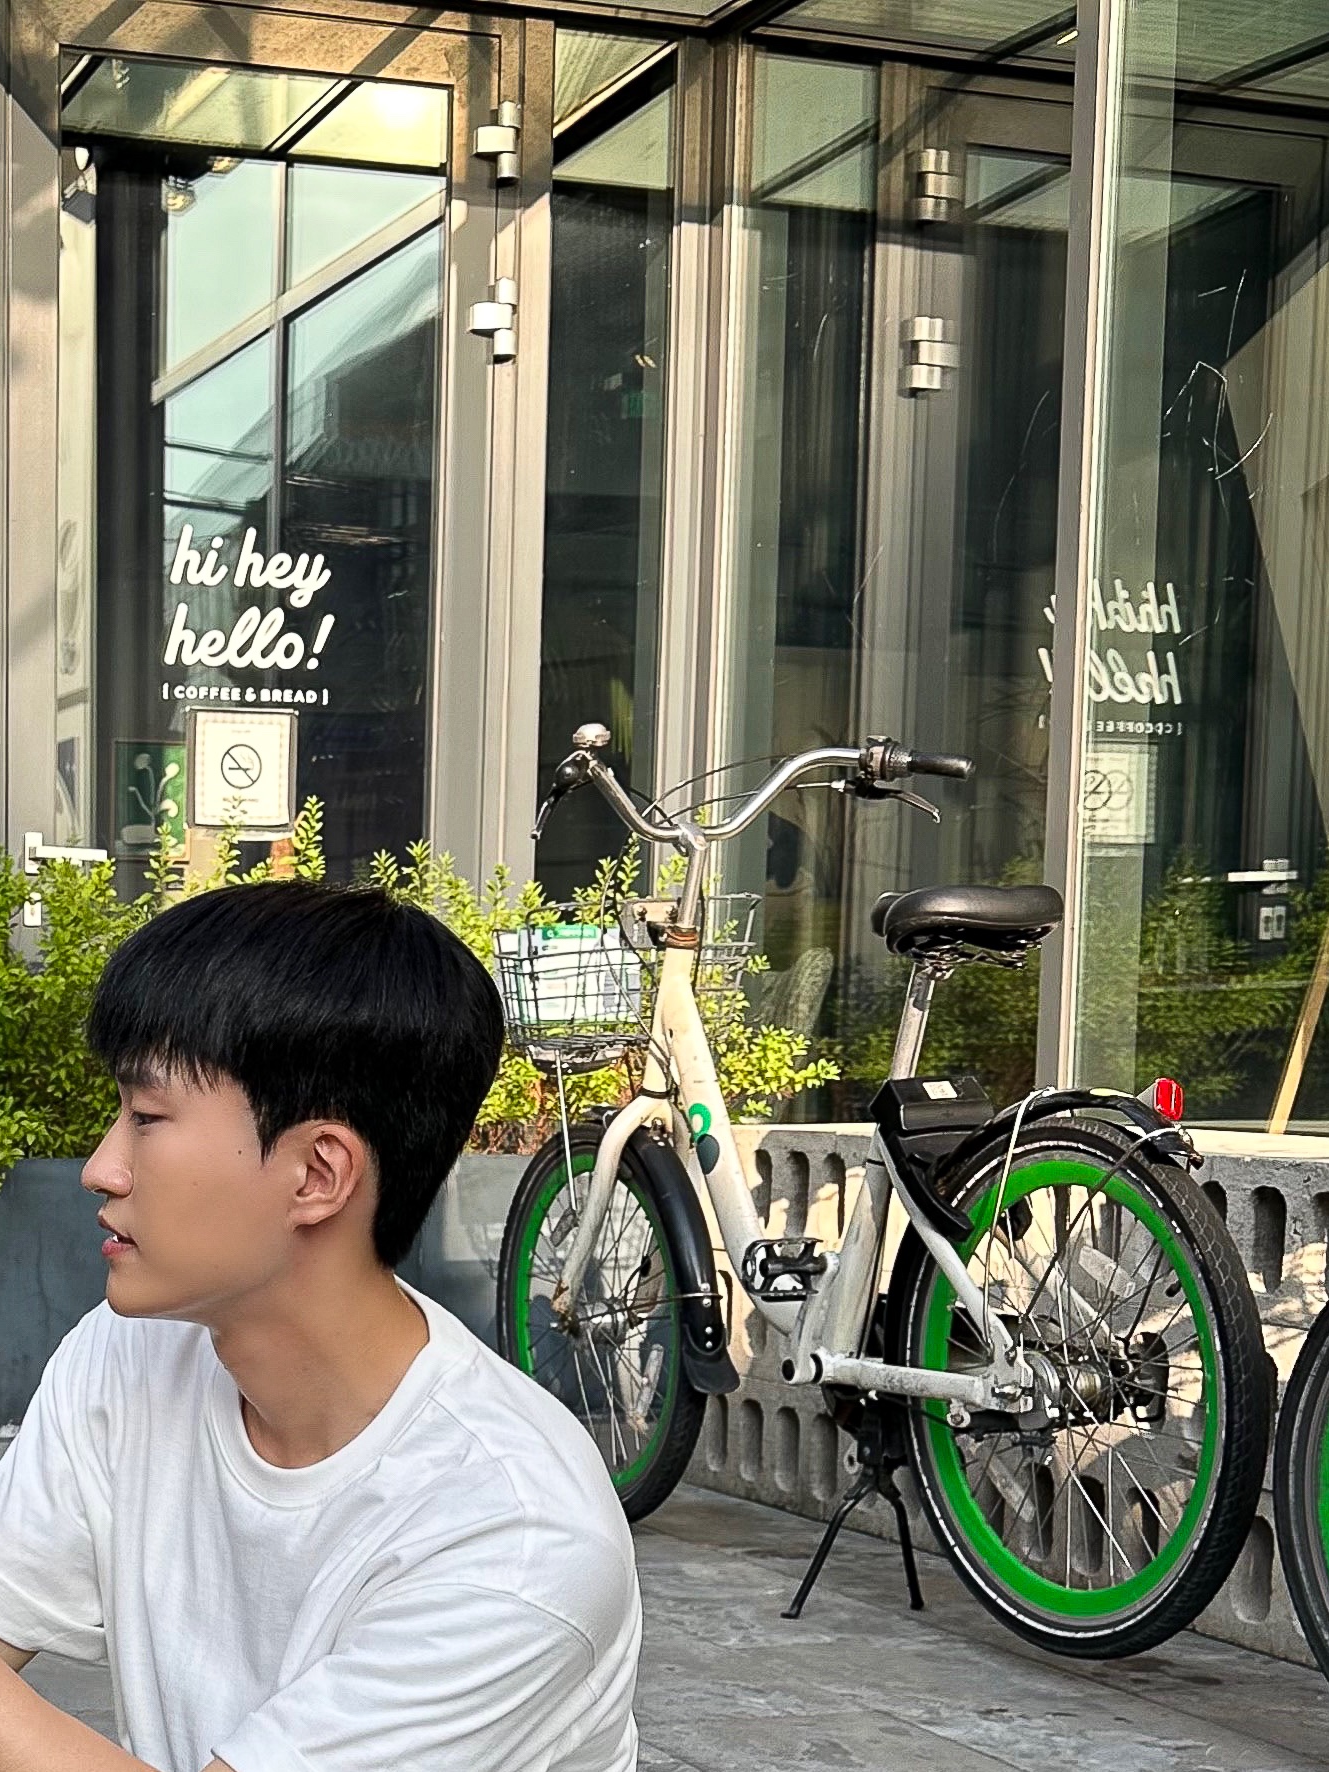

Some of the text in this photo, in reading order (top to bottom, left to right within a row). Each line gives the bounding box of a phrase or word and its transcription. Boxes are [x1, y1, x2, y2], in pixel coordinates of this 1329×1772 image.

[169, 523, 332, 608] hi hey
[163, 602, 336, 670] hello!
[173, 685, 242, 701] COFFEE
[259, 688, 318, 704] BREAD
